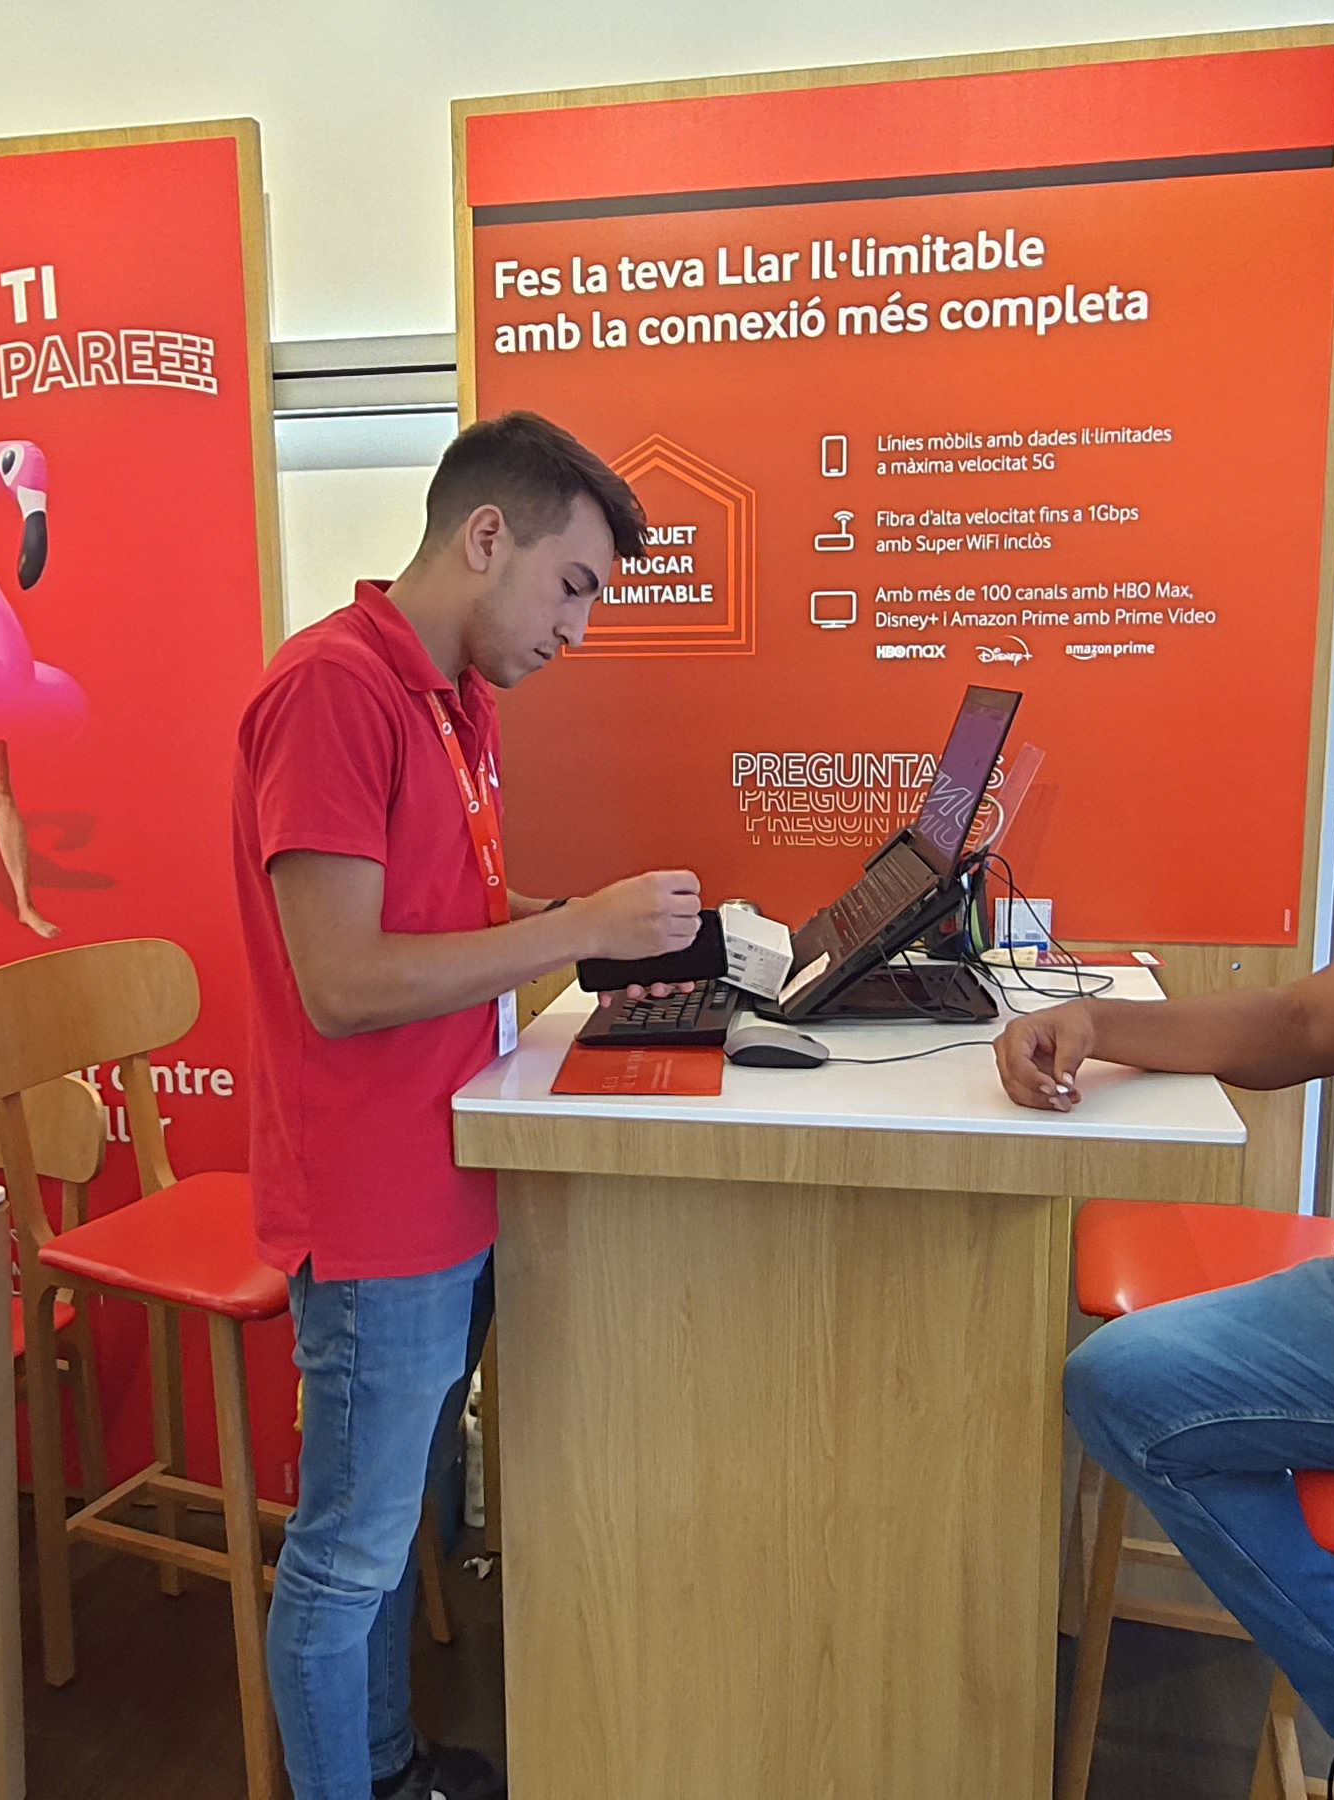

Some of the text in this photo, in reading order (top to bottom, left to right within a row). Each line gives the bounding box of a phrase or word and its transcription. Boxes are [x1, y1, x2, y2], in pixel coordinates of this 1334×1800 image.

[494, 228, 1045, 300] Fes la teva Llar Il·limitable
[0, 264, 58, 324] TI
[494, 284, 1149, 354] amb la connexió més completa
[877, 433, 924, 452] Línies
[927, 431, 983, 450] mòbils
[986, 431, 1024, 449] amb
[1027, 429, 1077, 447] dades
[876, 452, 1056, 475] a màxima velocitat 5G
[876, 504, 1139, 527] Fibra d'alta velocitat fins a 1Gbps
[638, 526, 697, 545] QUET
[875, 531, 1052, 555] amb Super WiFi inclòs
[621, 555, 694, 575] HOGAR
[603, 584, 714, 604] ILIMITABLE
[874, 581, 1194, 603] Amb més de 100 canals amb HBO Max,
[874, 611, 939, 631] Disney+
[950, 610, 1017, 628] Amazon
[1021, 609, 1070, 627] Prime
[1072, 609, 1110, 625] amb
[1114, 608, 1163, 625] Prime
[1166, 607, 1217, 624] Video
